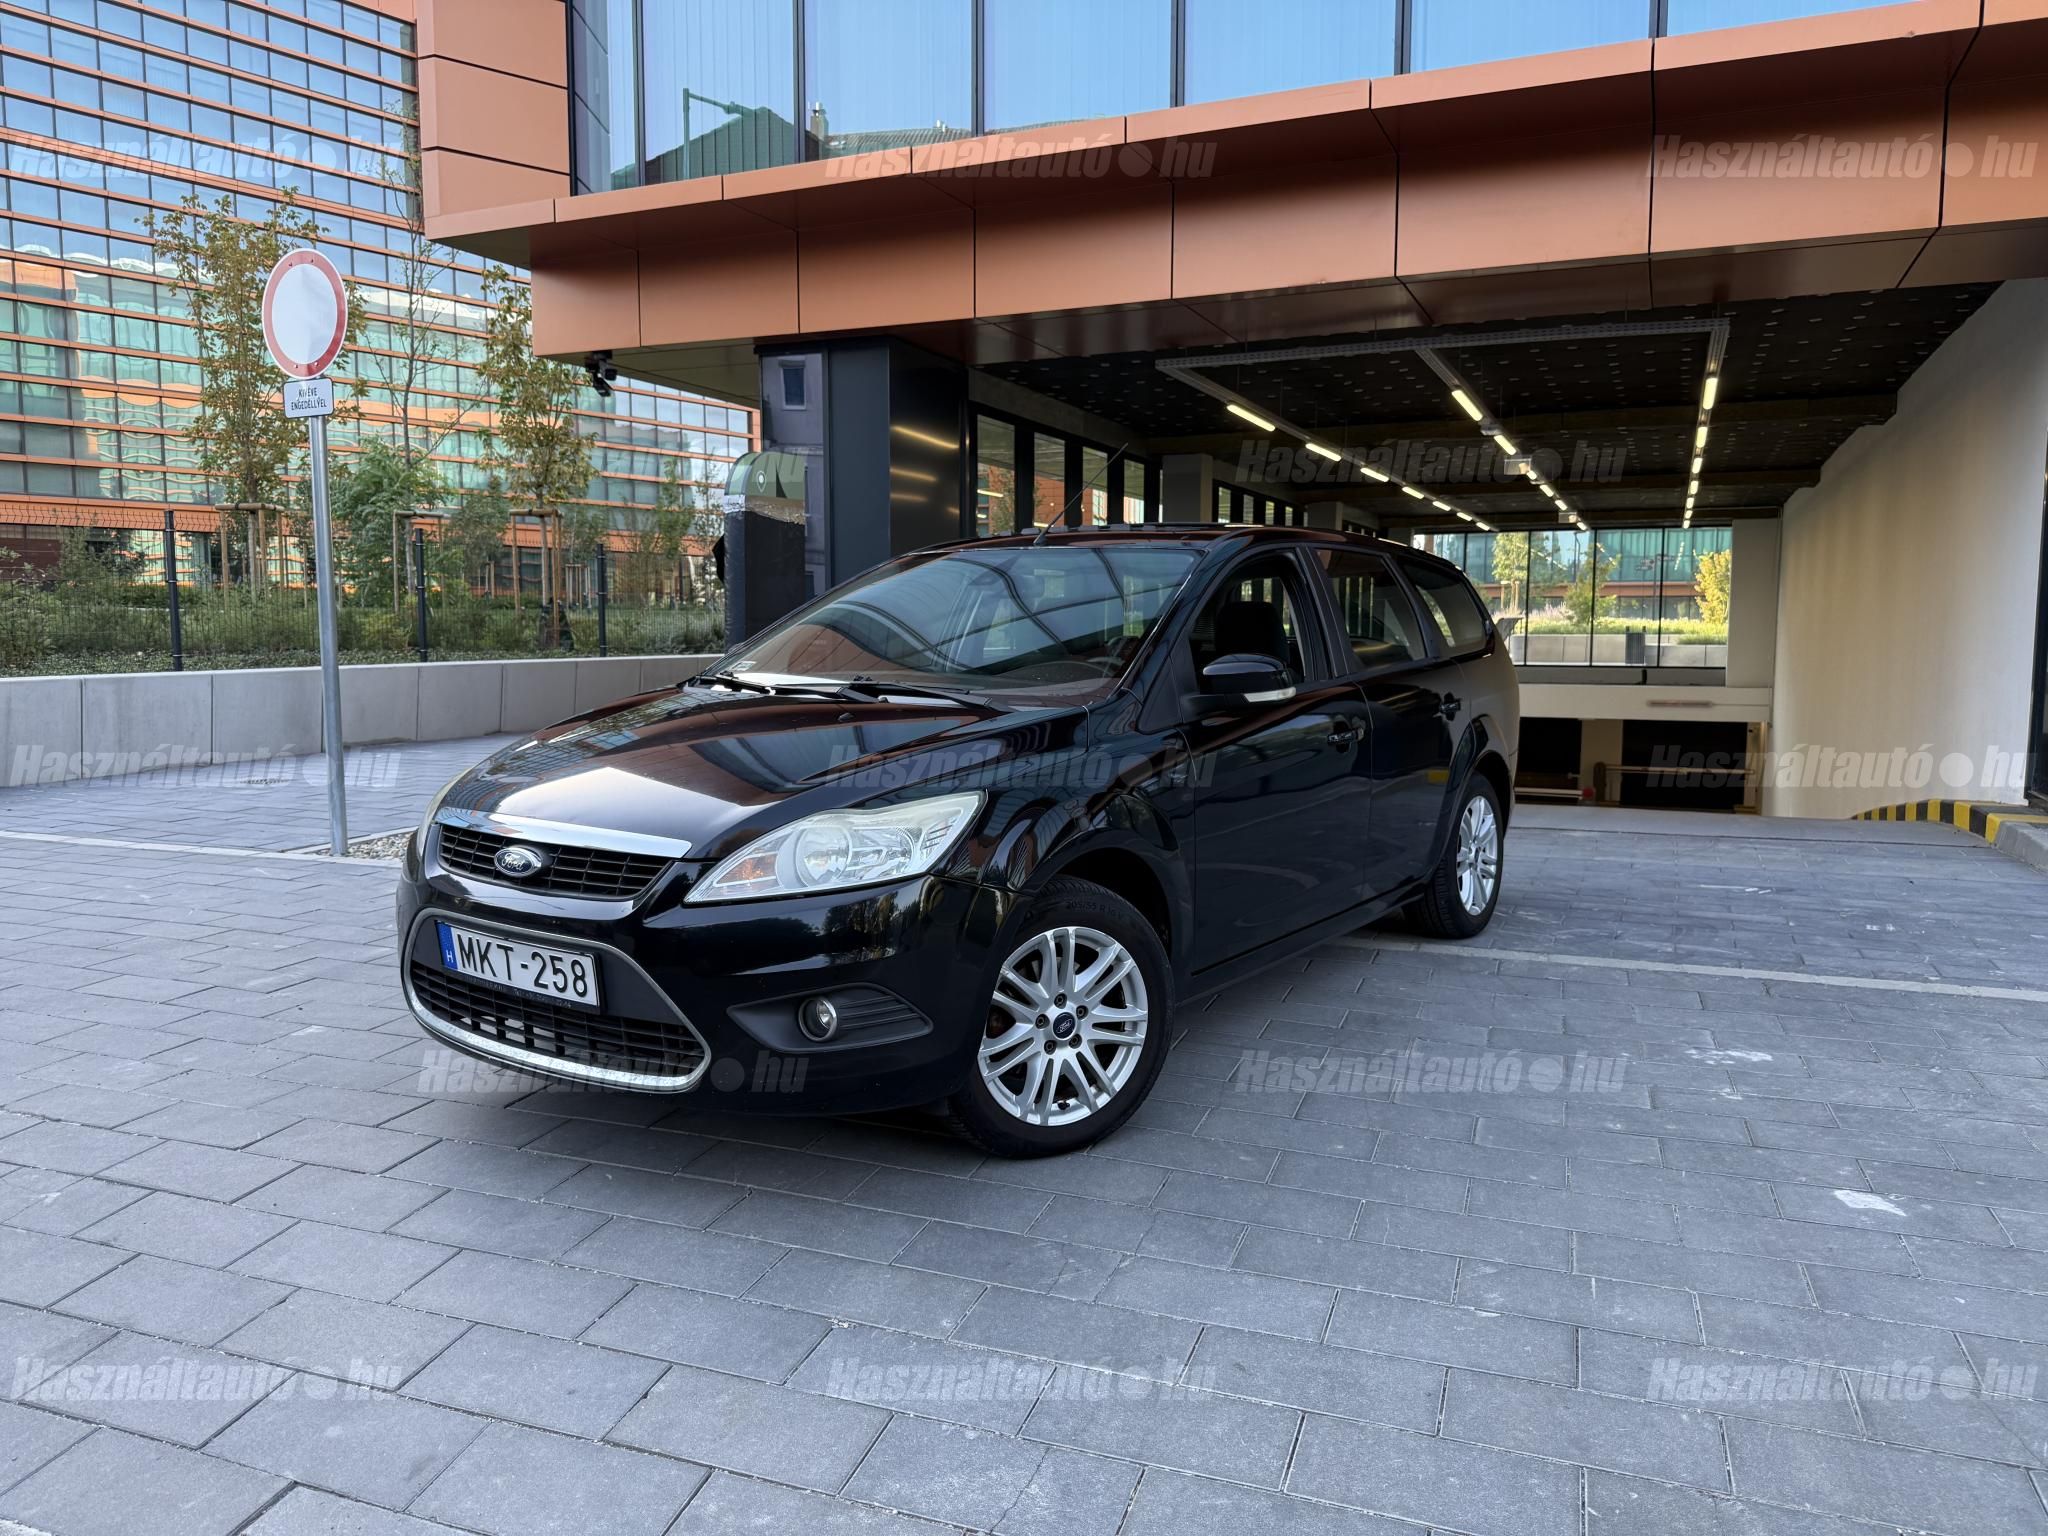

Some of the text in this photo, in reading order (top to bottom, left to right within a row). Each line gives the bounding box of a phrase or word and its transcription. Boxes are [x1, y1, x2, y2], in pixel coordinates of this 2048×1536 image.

[502, 852, 525, 871] Ford
[446, 950, 454, 963] H
[457, 933, 588, 998] MKT-258
